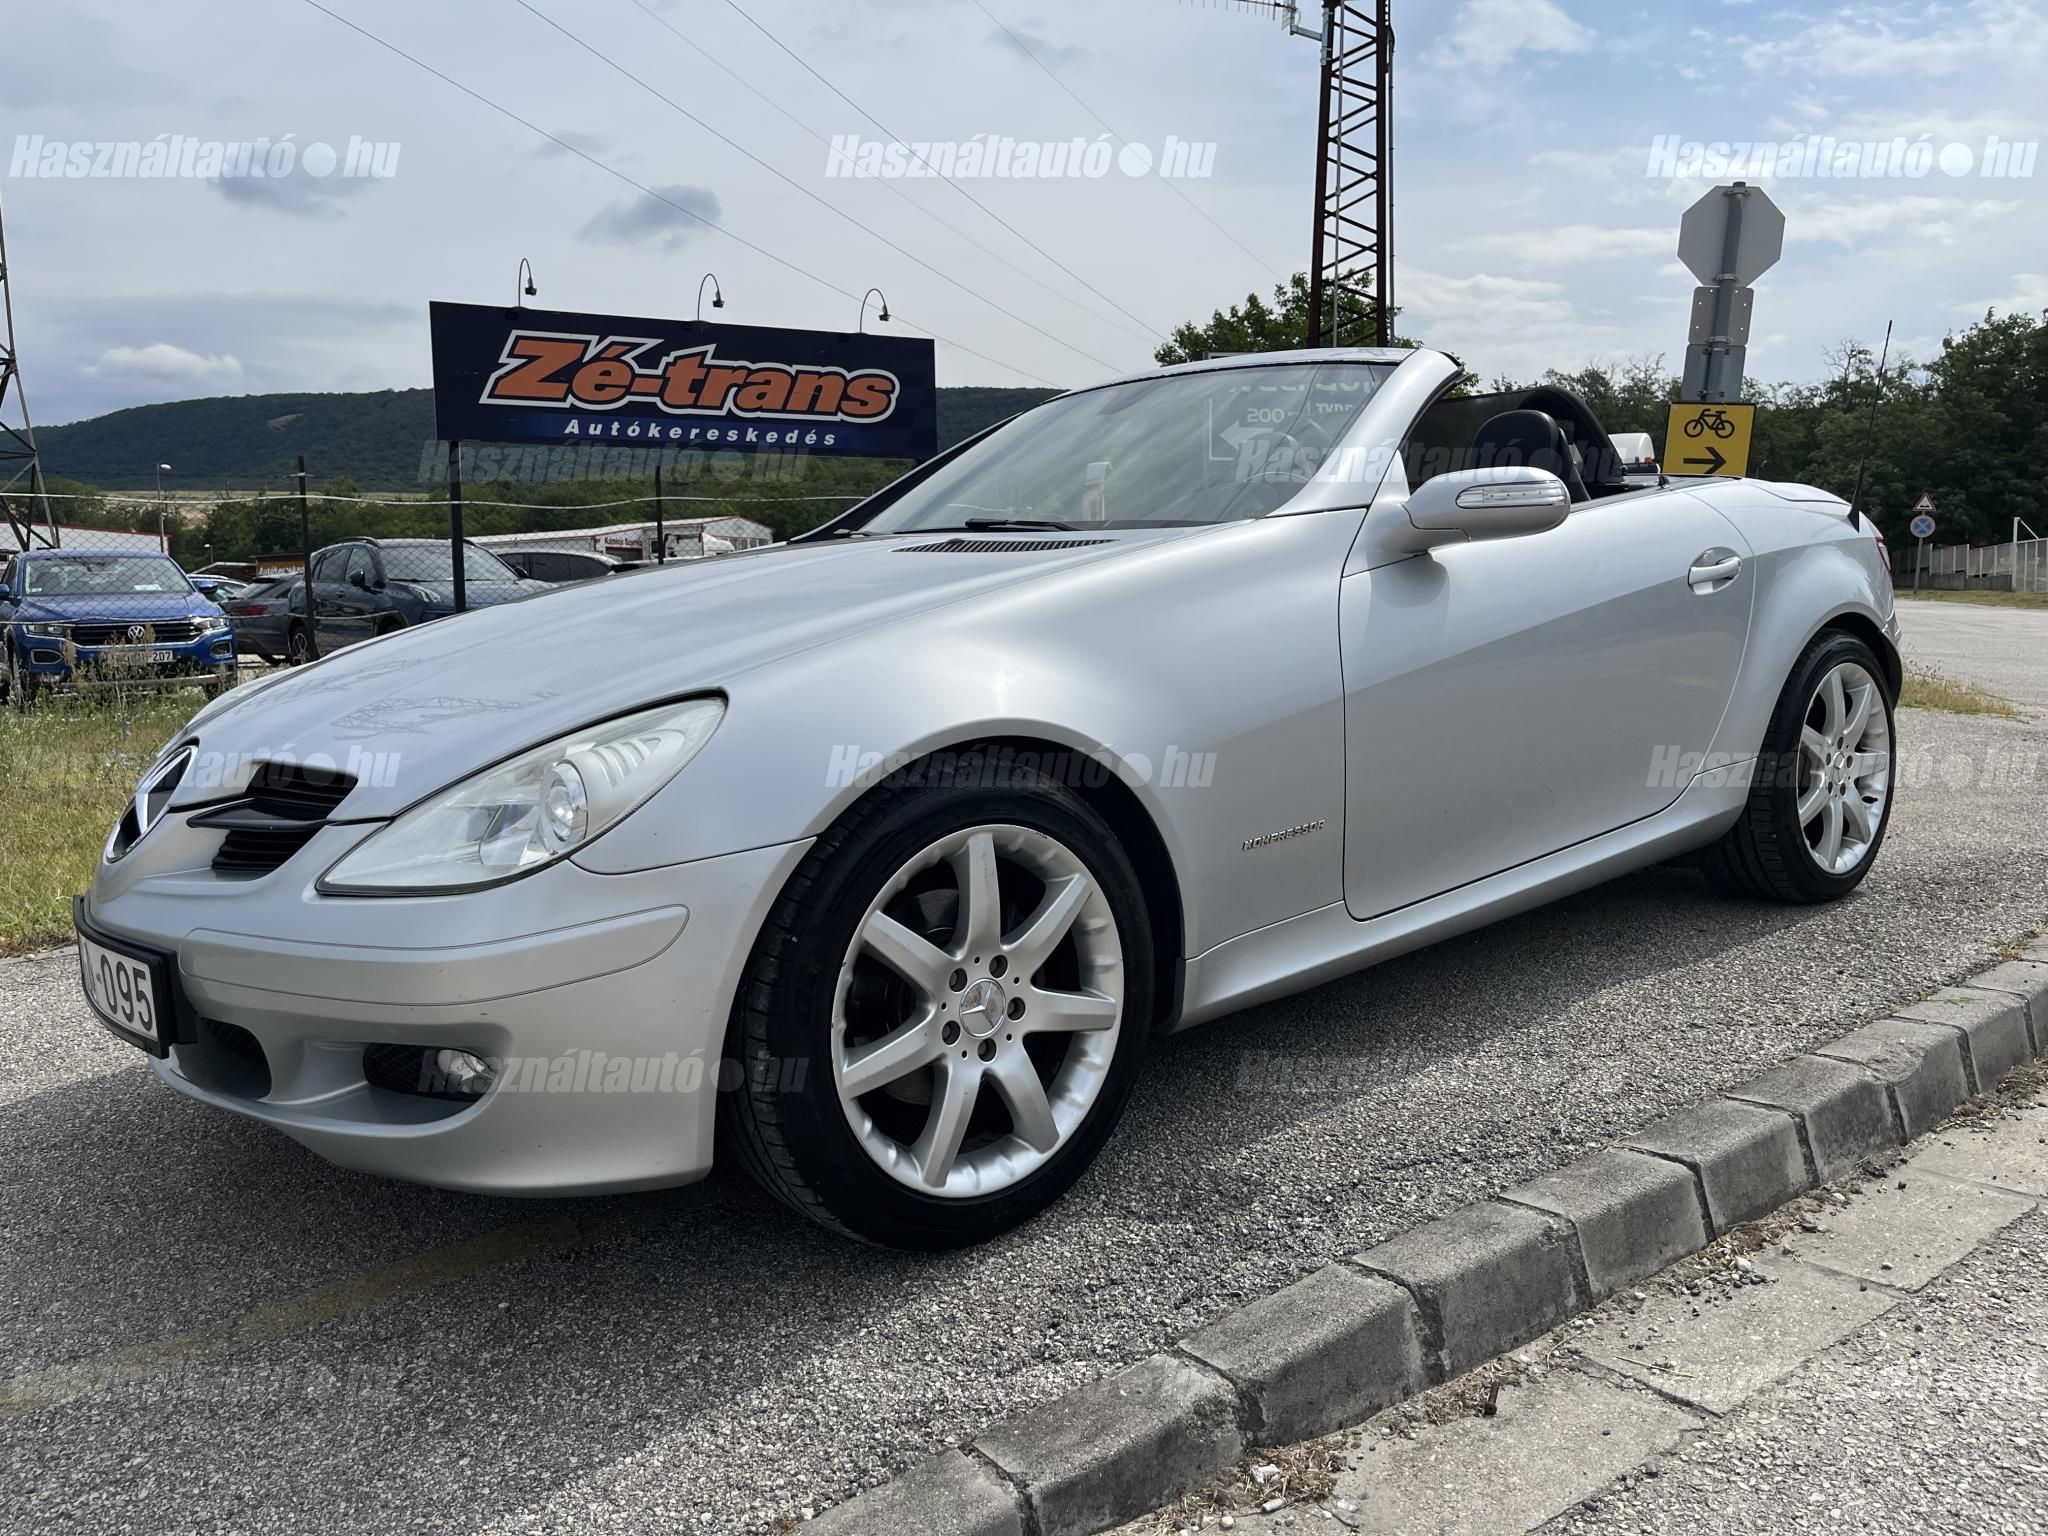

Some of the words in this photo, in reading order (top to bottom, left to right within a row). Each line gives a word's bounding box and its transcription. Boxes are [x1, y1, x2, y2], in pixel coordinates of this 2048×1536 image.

[485, 333, 898, 420] Zé-trans
[564, 418, 836, 446] Autókereskedés
[1242, 819, 1326, 851] KOMPRESSOR
[85, 942, 153, 1032] -095
